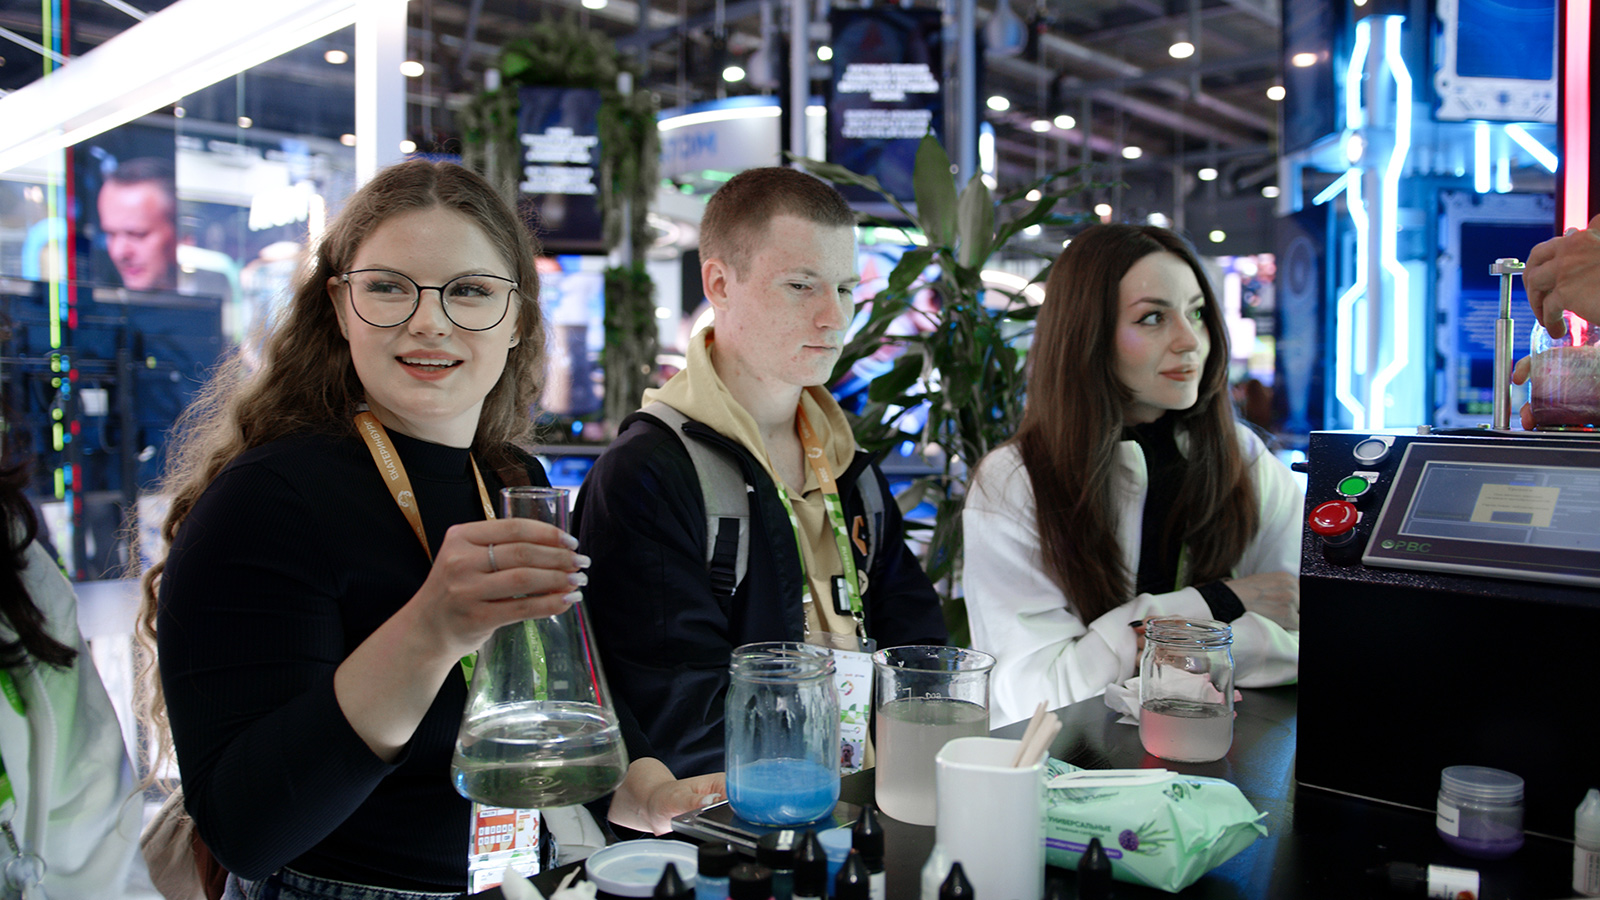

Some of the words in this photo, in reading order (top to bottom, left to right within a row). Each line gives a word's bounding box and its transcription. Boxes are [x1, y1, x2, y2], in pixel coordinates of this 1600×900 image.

[363, 421, 400, 481] ЕКАТЕРИНБУРГ
[841, 546, 852, 574] RUSSIA
[1048, 816, 1112, 832] УНИВЕРСАЛЬНЫЕ
